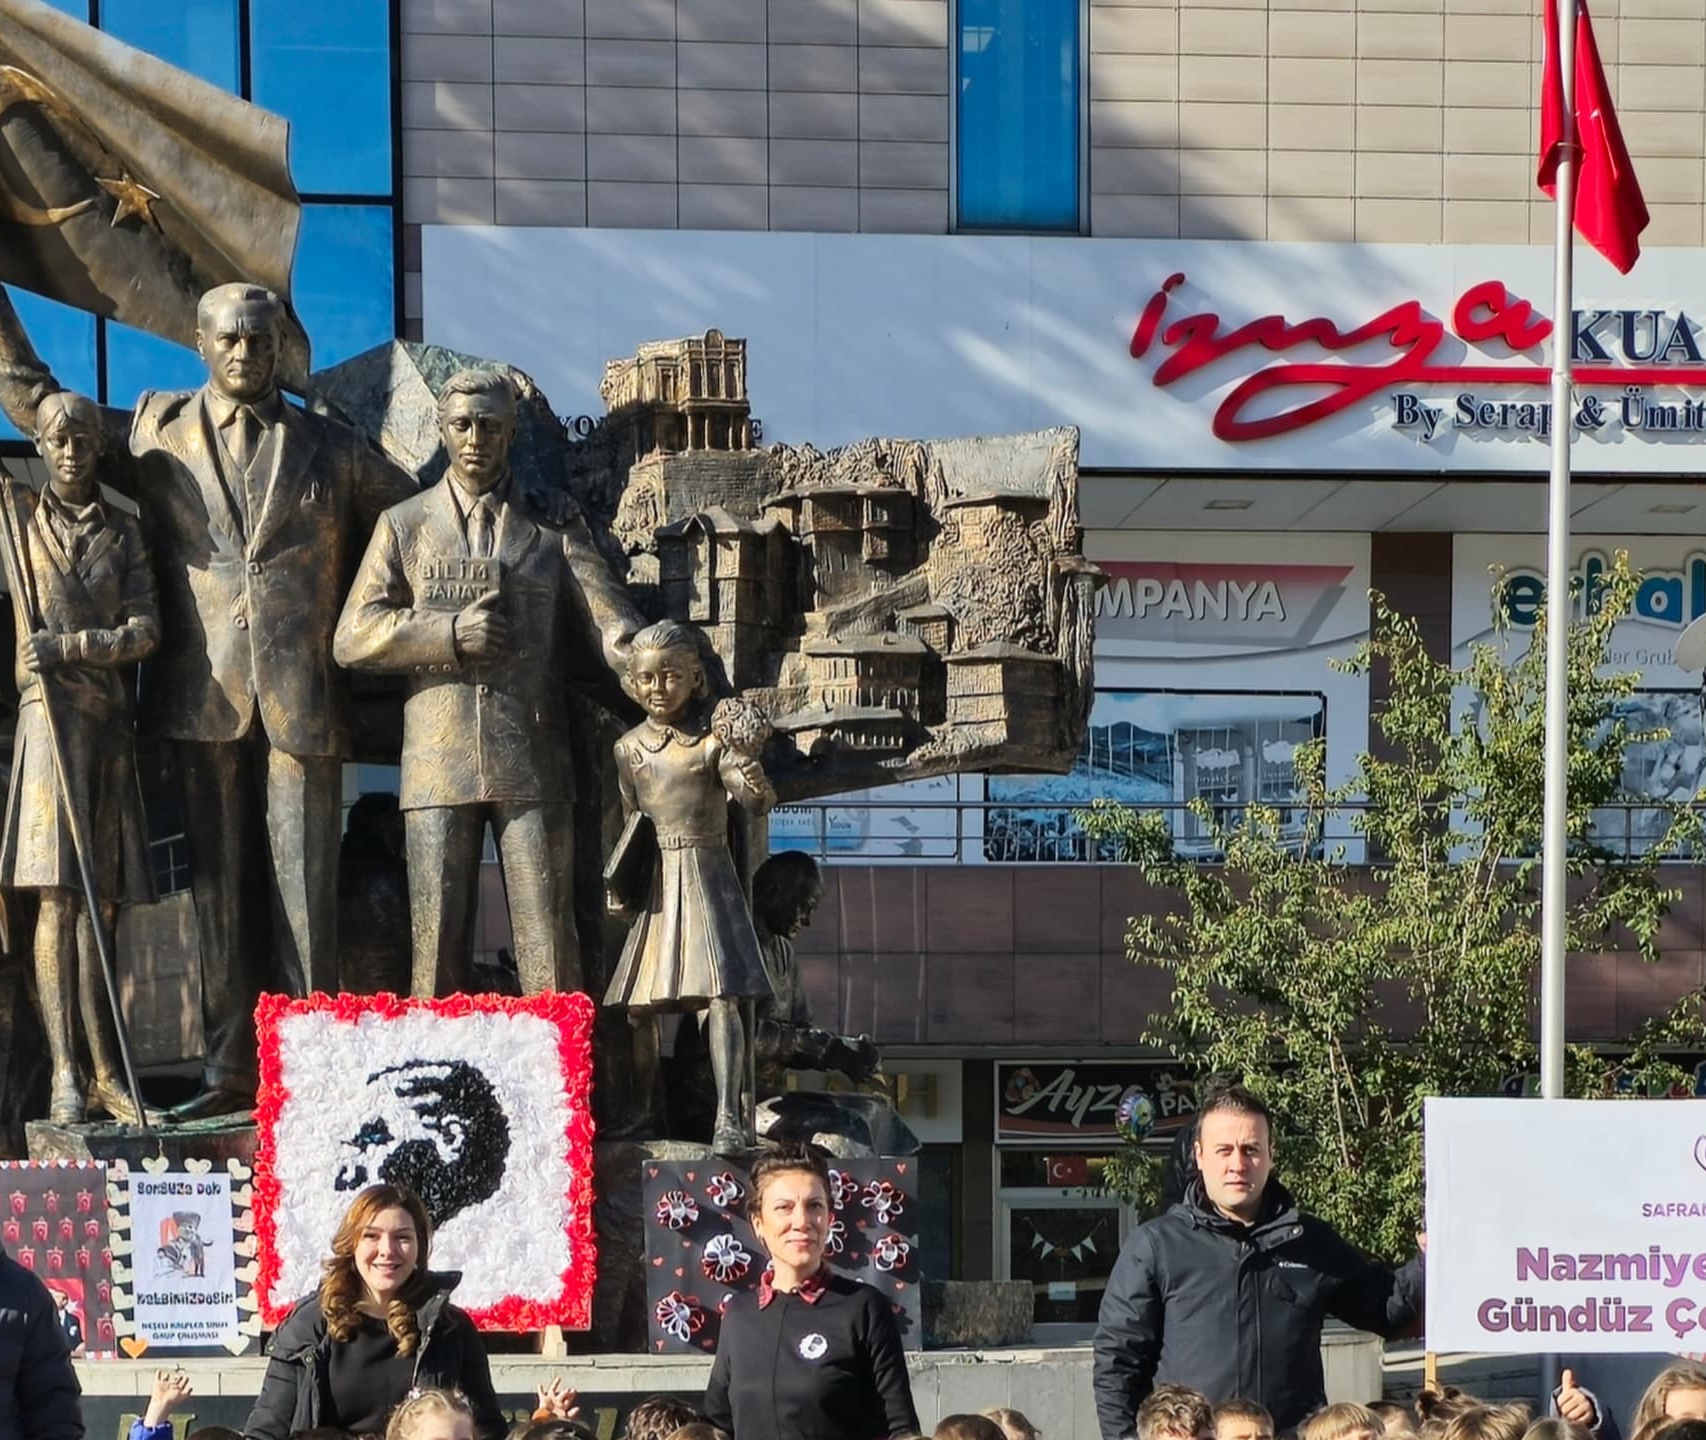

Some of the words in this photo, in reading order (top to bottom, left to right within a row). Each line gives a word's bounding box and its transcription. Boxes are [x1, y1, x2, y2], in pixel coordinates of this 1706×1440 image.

[1392, 392, 1444, 440] By
[1575, 395, 1605, 430] &
[1094, 577, 1287, 623] MPANYA
[1477, 1294, 1653, 1334] Gündüz
